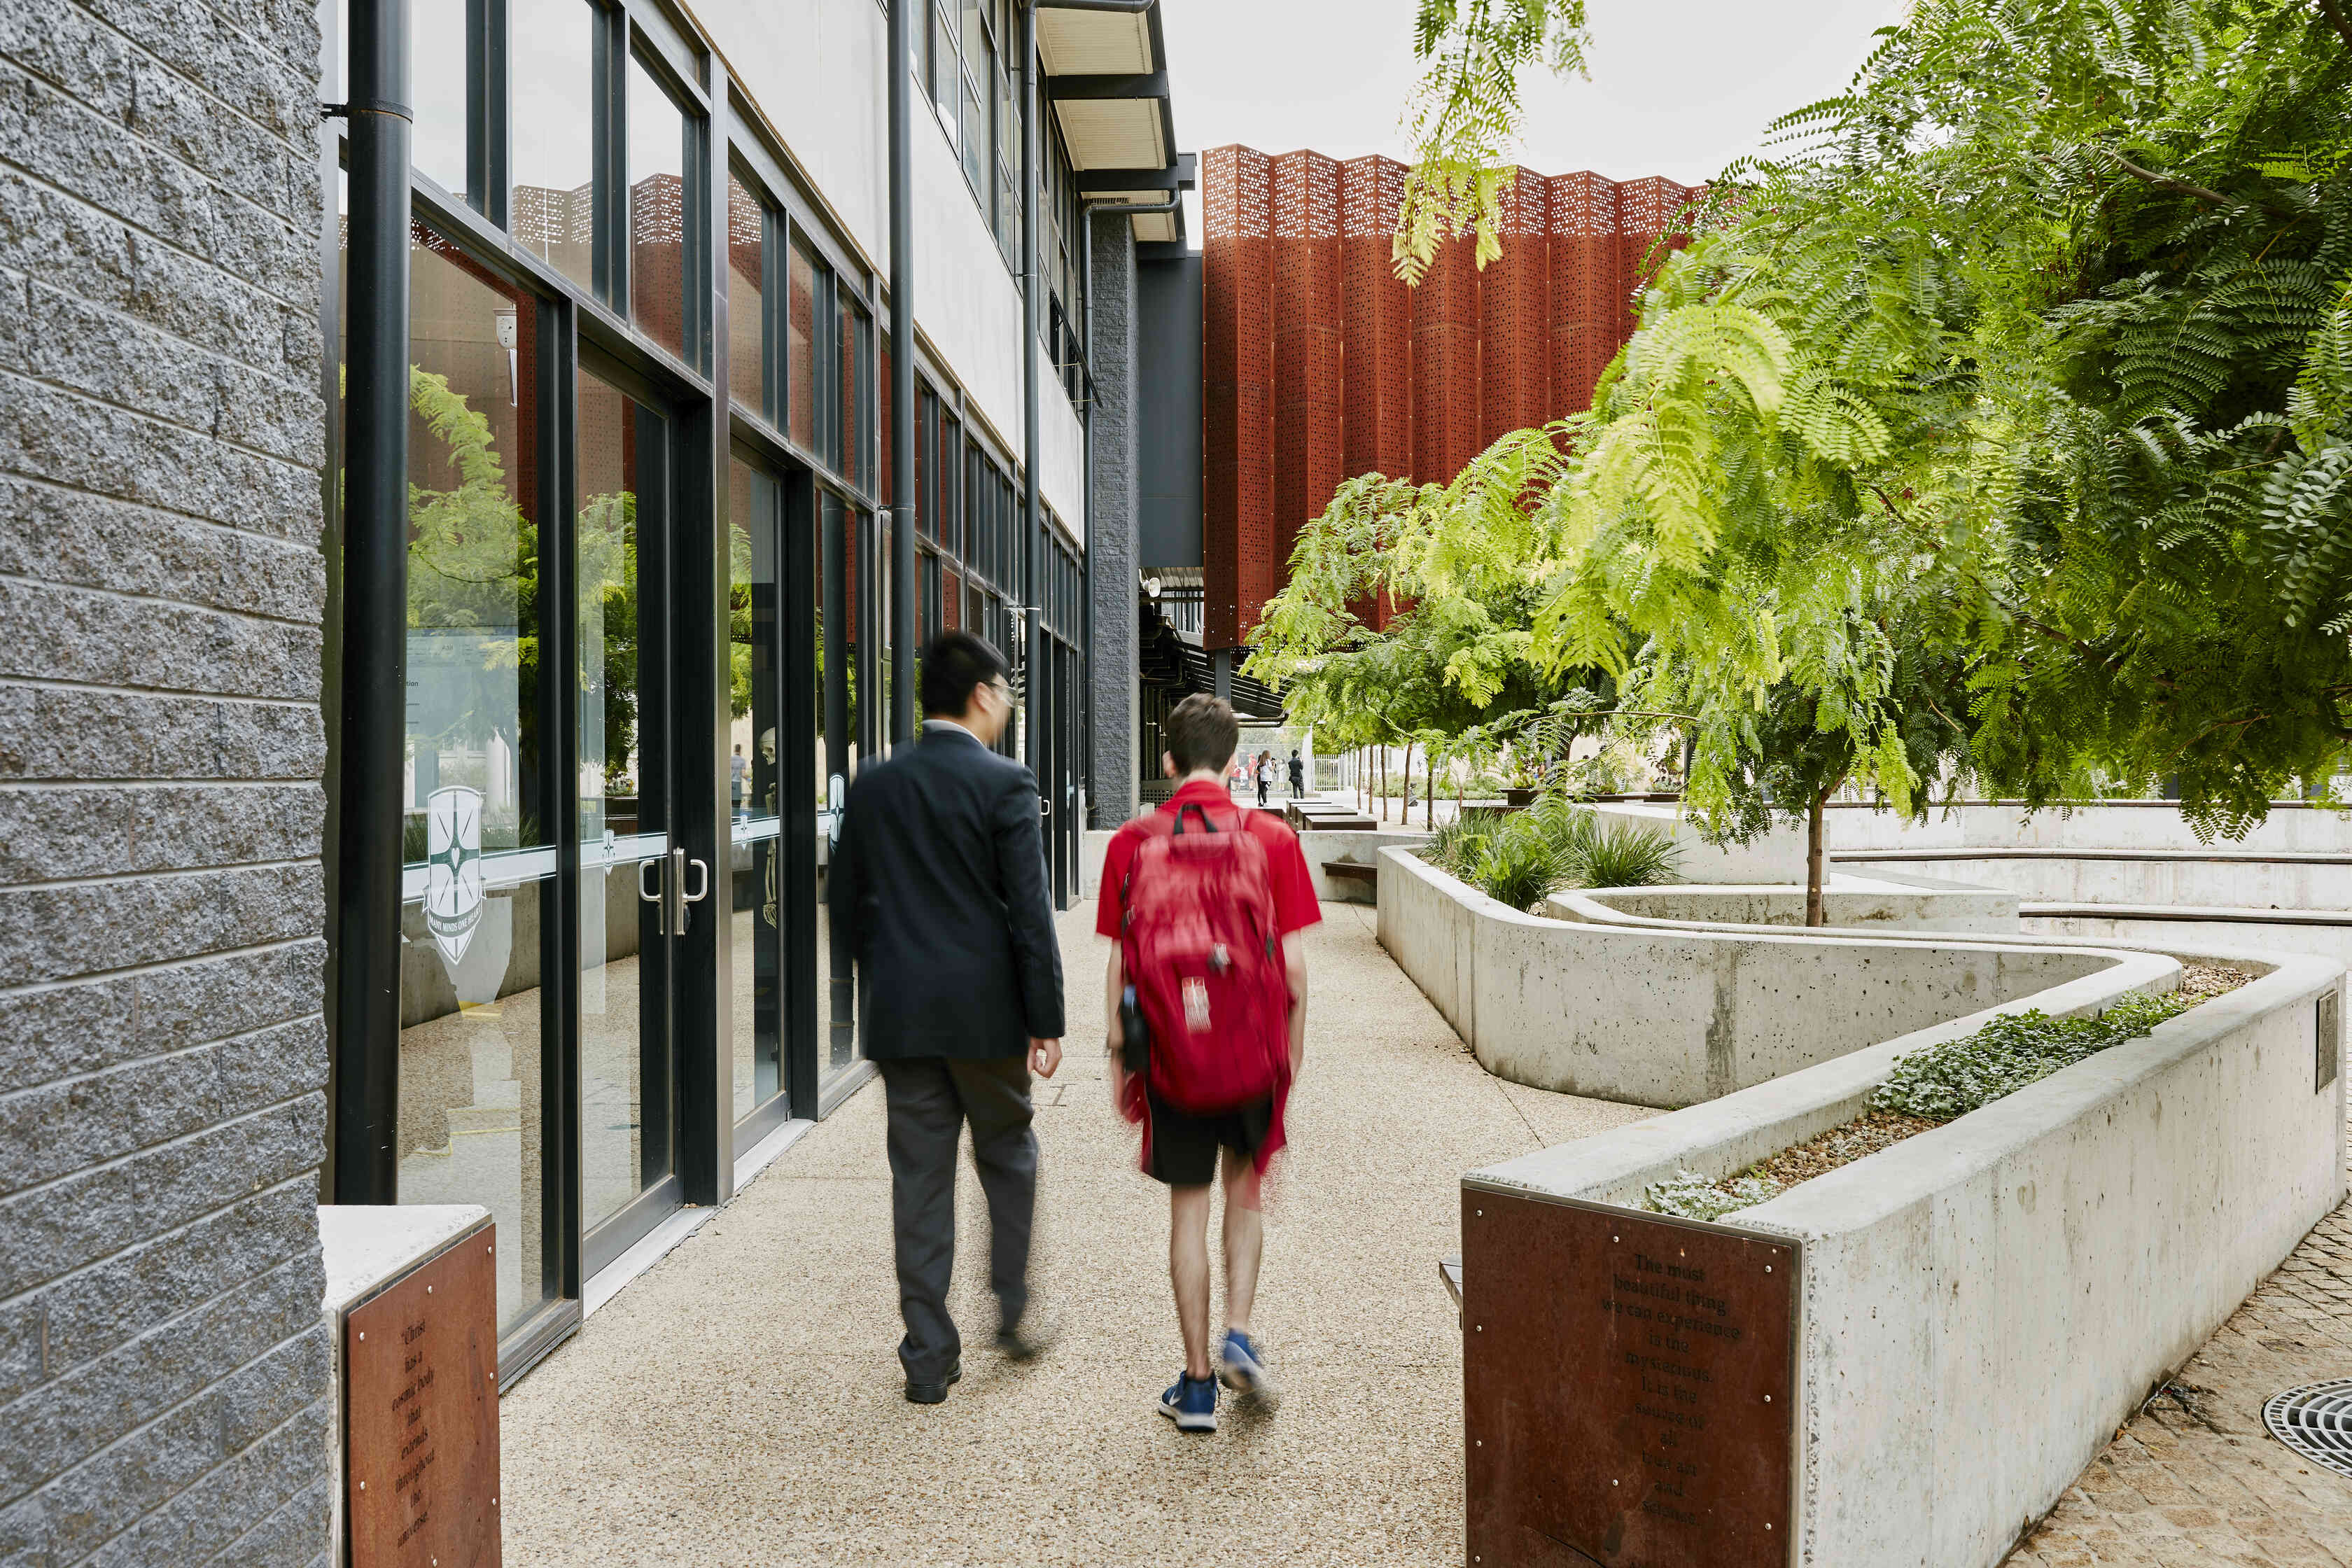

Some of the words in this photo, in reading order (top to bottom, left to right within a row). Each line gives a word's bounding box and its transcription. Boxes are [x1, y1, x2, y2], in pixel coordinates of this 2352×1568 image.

[429, 913, 442, 930] MANY
[458, 918, 467, 930] ONE
[468, 902, 480, 924] HEART
[1635, 1254, 1663, 1274] The
[1613, 1273, 1680, 1301] beautiful
[1686, 1289, 1726, 1316] thing
[1602, 1298, 1622, 1314] we
[1627, 1305, 1652, 1322] can
[1657, 1311, 1742, 1338] experience
[1665, 1334, 1689, 1352] the
[405, 1354, 417, 1373] has
[392, 1383, 416, 1411] cosmic
[1642, 1375, 1653, 1393] It
[1674, 1384, 1697, 1404] the
[409, 1405, 421, 1426] that
[402, 1425, 428, 1460] extends
[396, 1447, 435, 1494] throughout
[410, 1489, 421, 1508] the
